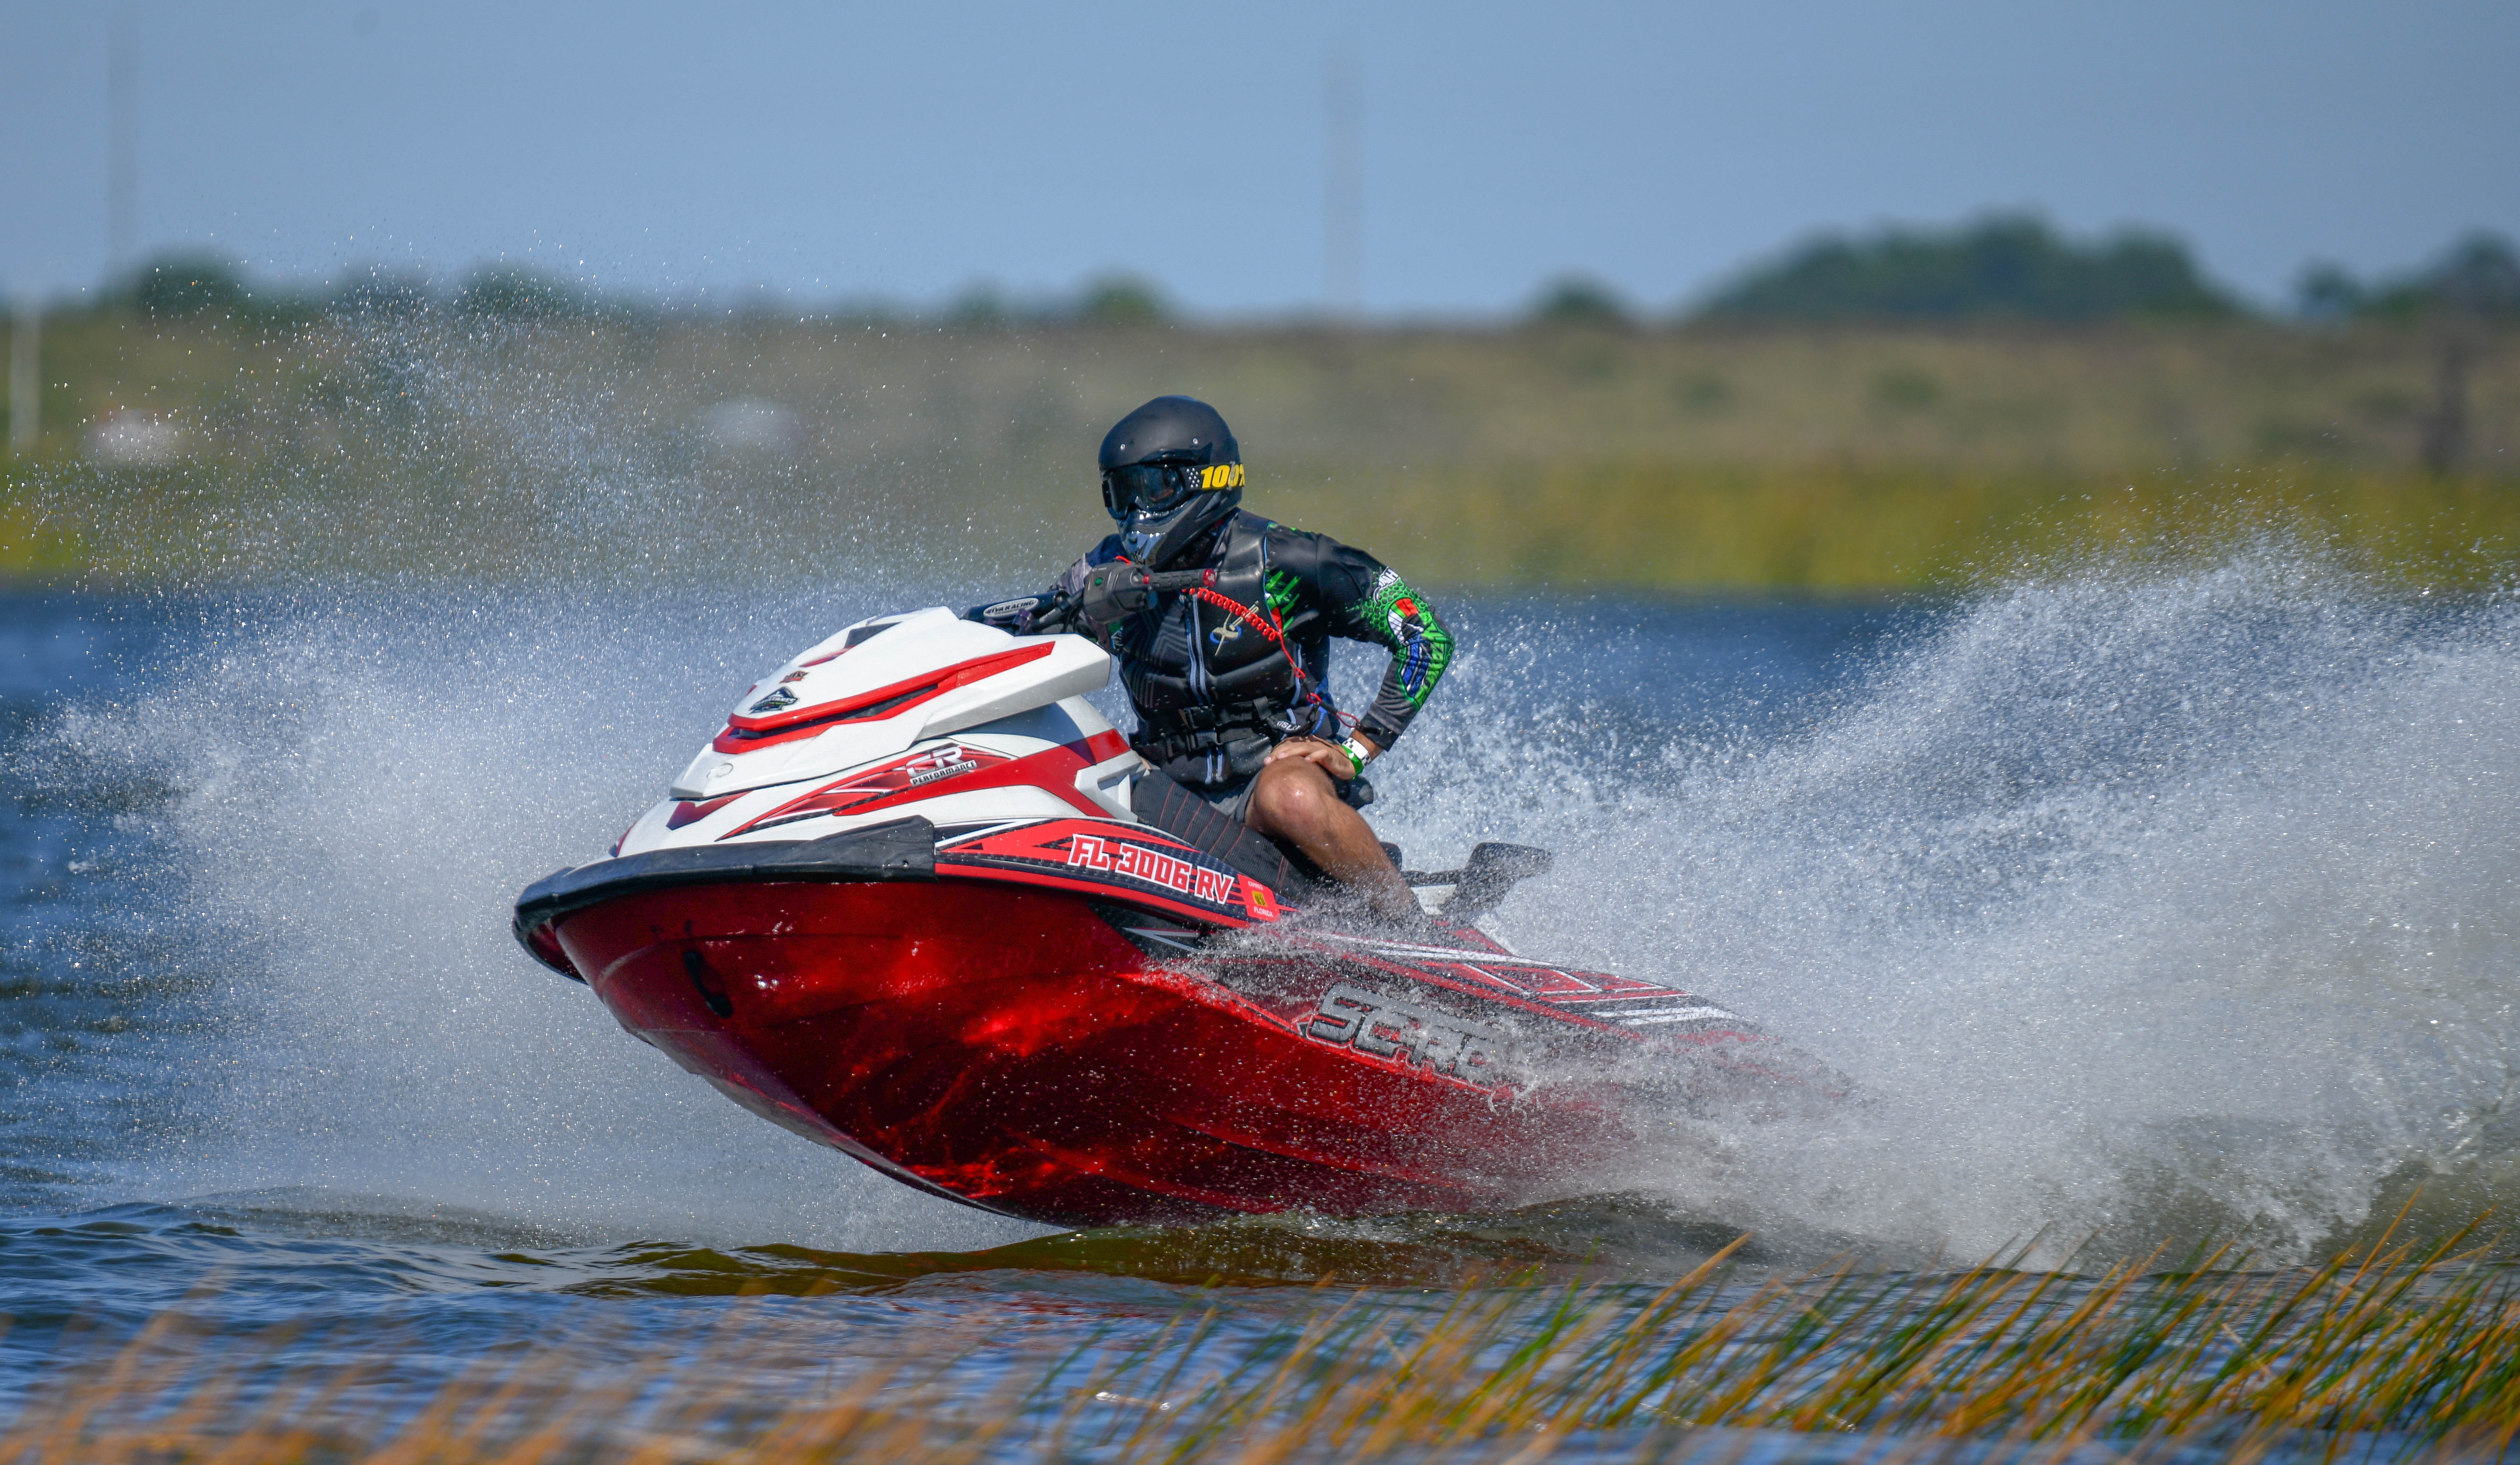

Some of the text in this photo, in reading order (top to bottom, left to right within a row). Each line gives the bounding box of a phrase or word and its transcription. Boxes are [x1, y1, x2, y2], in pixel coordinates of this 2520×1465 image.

[1004, 600, 1035, 610] RACING
[912, 762, 976, 785] PERFORMANCE
[1067, 834, 1110, 871] FL
[1115, 843, 1192, 893] 3006
[1194, 866, 1234, 905] RV
[1248, 880, 1263, 890] EXPIRES
[1253, 906, 1274, 918] FLORIDA
